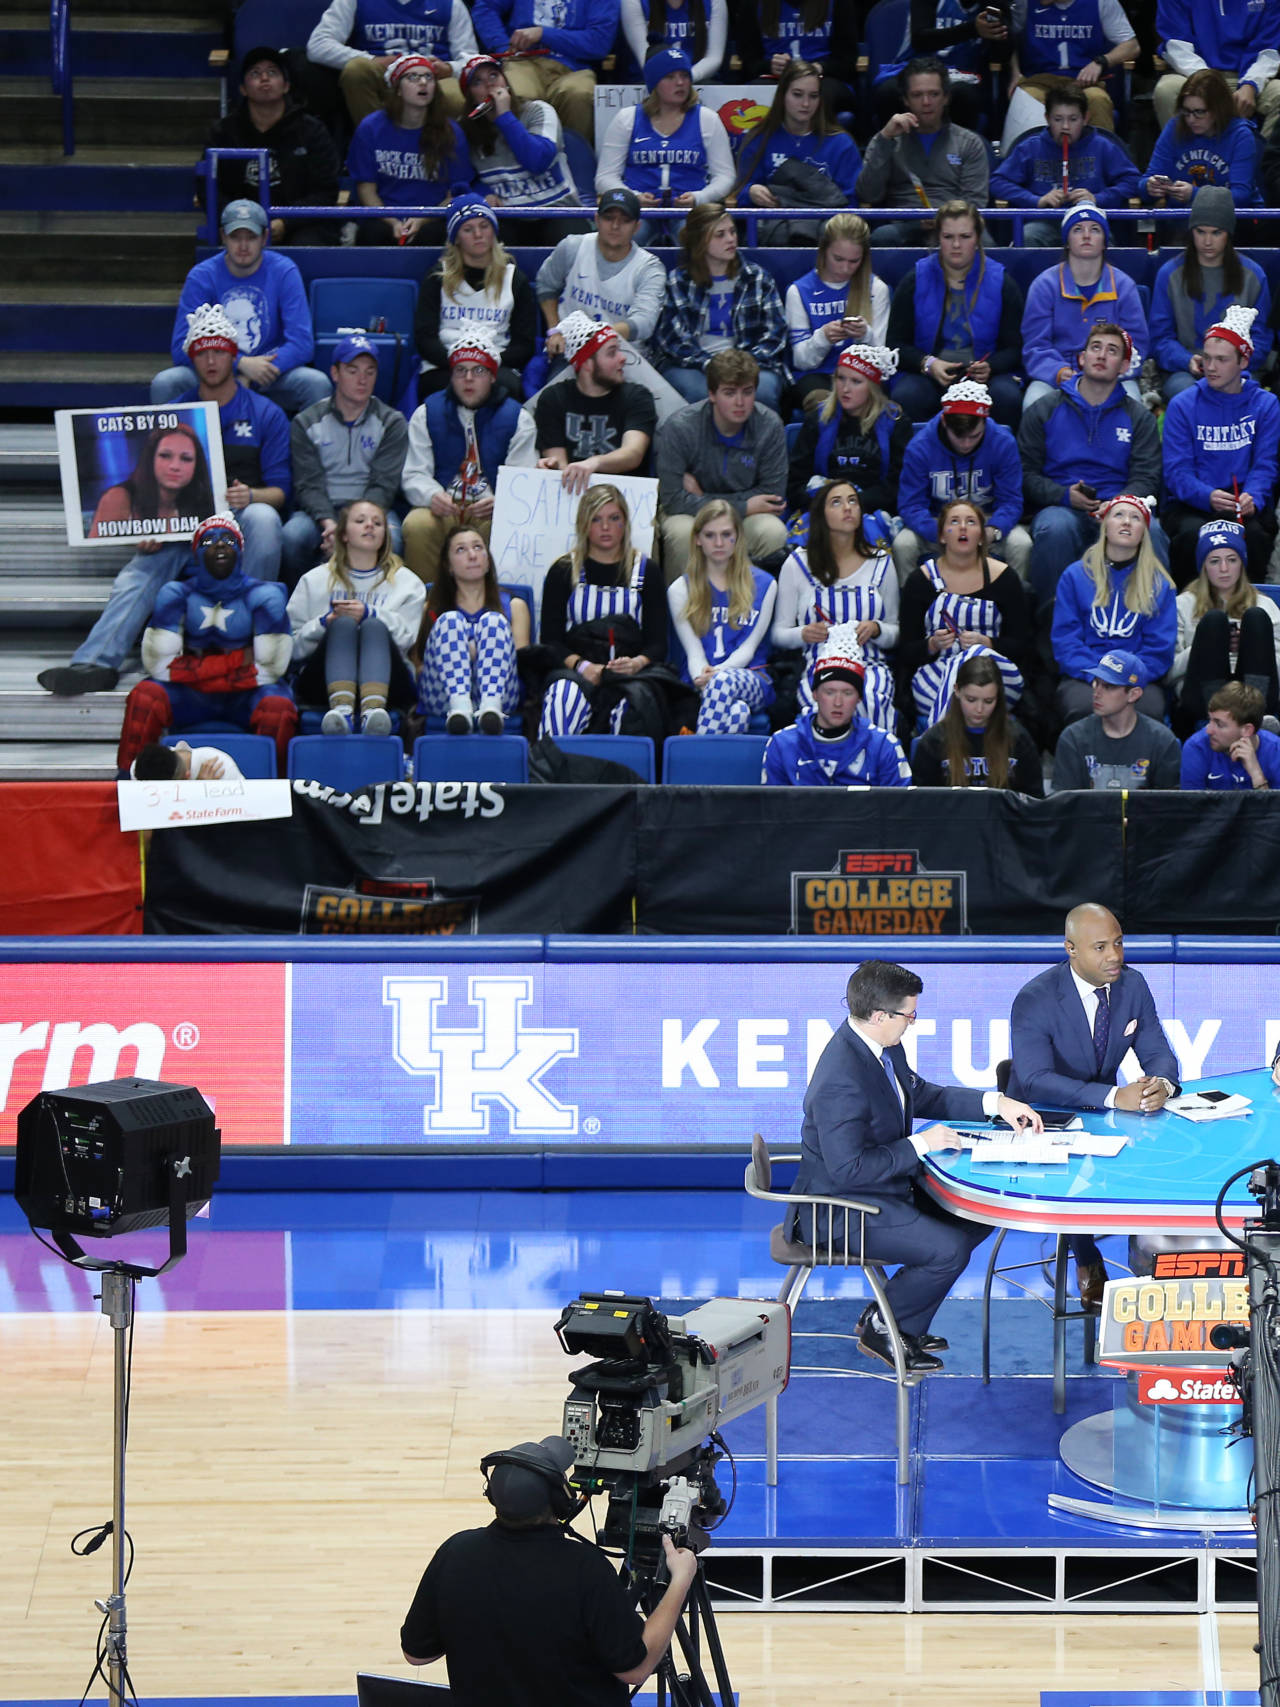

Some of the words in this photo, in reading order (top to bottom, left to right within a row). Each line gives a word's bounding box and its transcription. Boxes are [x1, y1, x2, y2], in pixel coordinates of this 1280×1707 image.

[365, 24, 444, 42] KENTUCKY
[1034, 25, 1092, 39] KENTUCKY
[1057, 42, 1069, 69] 1
[632, 151, 700, 166] KENTUCKY
[1176, 149, 1231, 174] KENTUCKY
[660, 165, 669, 190] 1
[571, 286, 633, 316] KENTUCKY
[810, 301, 847, 315] KENTU
[98, 416, 134, 433] CATS
[137, 415, 157, 431] BY
[158, 413, 178, 430] 90
[1198, 420, 1257, 441] KENTUCKY
[1116, 427, 1131, 443] UK
[98, 516, 165, 537] HOWBOW
[168, 515, 201, 534] DAH
[500, 531, 545, 567] ARE
[1209, 533, 1228, 546] UK
[712, 626, 728, 659] 1
[203, 779, 246, 799] lead
[846, 854, 914, 873] ESPN
[805, 879, 952, 910] COLLEGE
[812, 909, 946, 935] GAMEDAY
[382, 975, 580, 1135] UK
[1154, 1253, 1247, 1277] ESPN
